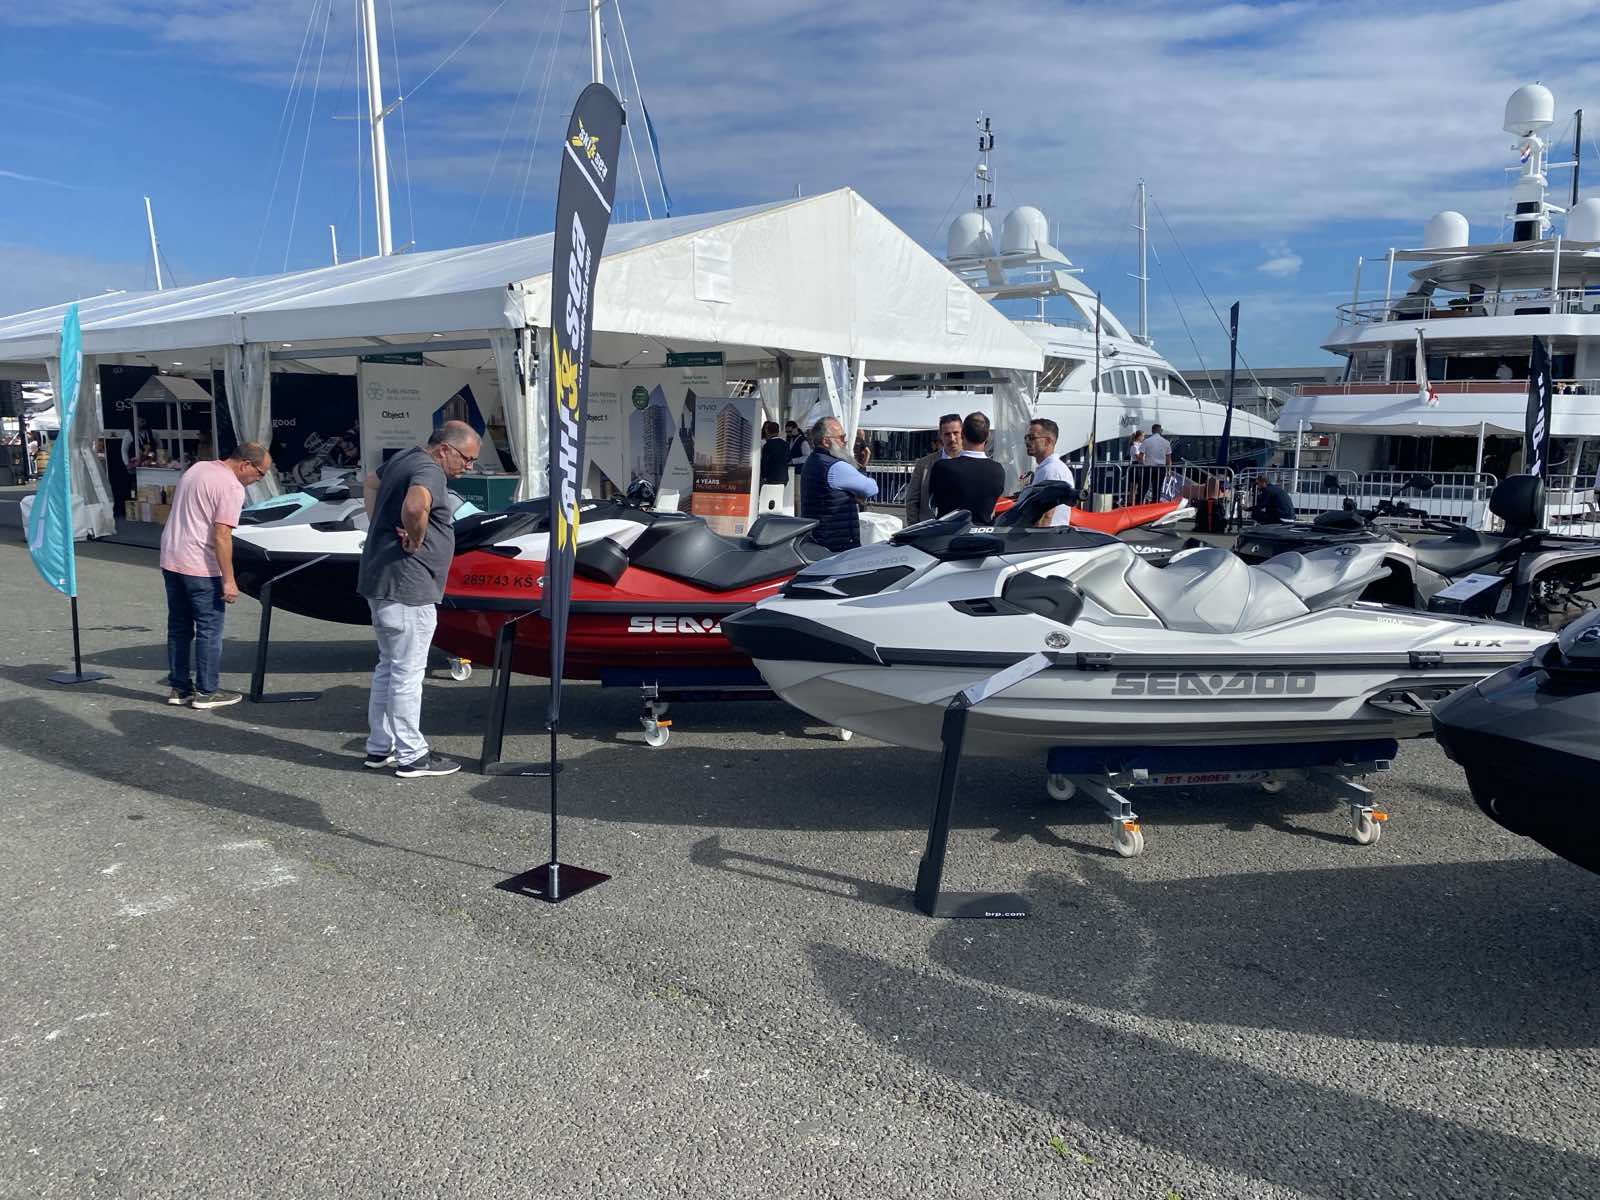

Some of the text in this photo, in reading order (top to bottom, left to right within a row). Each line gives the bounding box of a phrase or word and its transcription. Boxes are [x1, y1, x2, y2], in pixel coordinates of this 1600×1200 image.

[566, 211, 586, 350] sea
[272, 418, 296, 428] good
[463, 574, 509, 586] 289743
